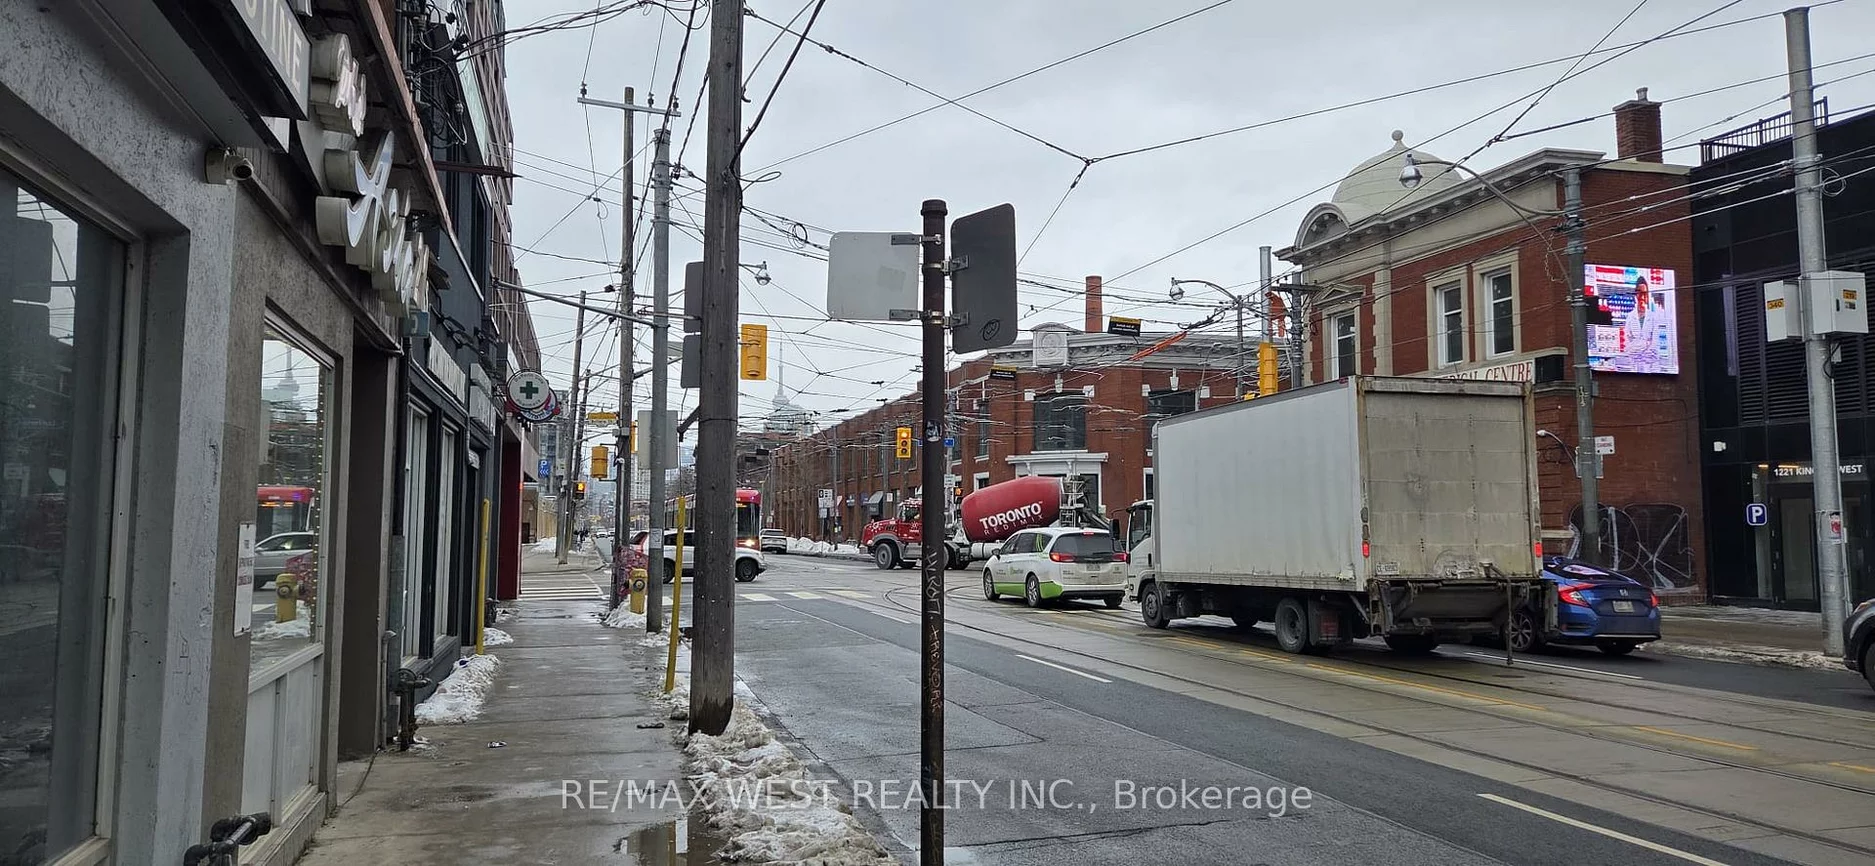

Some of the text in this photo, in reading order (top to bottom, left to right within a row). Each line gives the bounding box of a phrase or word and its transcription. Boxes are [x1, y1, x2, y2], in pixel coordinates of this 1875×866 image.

[1486, 362, 1532, 381] CENTRE
[1774, 468, 1793, 476] 1221
[979, 503, 1041, 529] TORONTO
